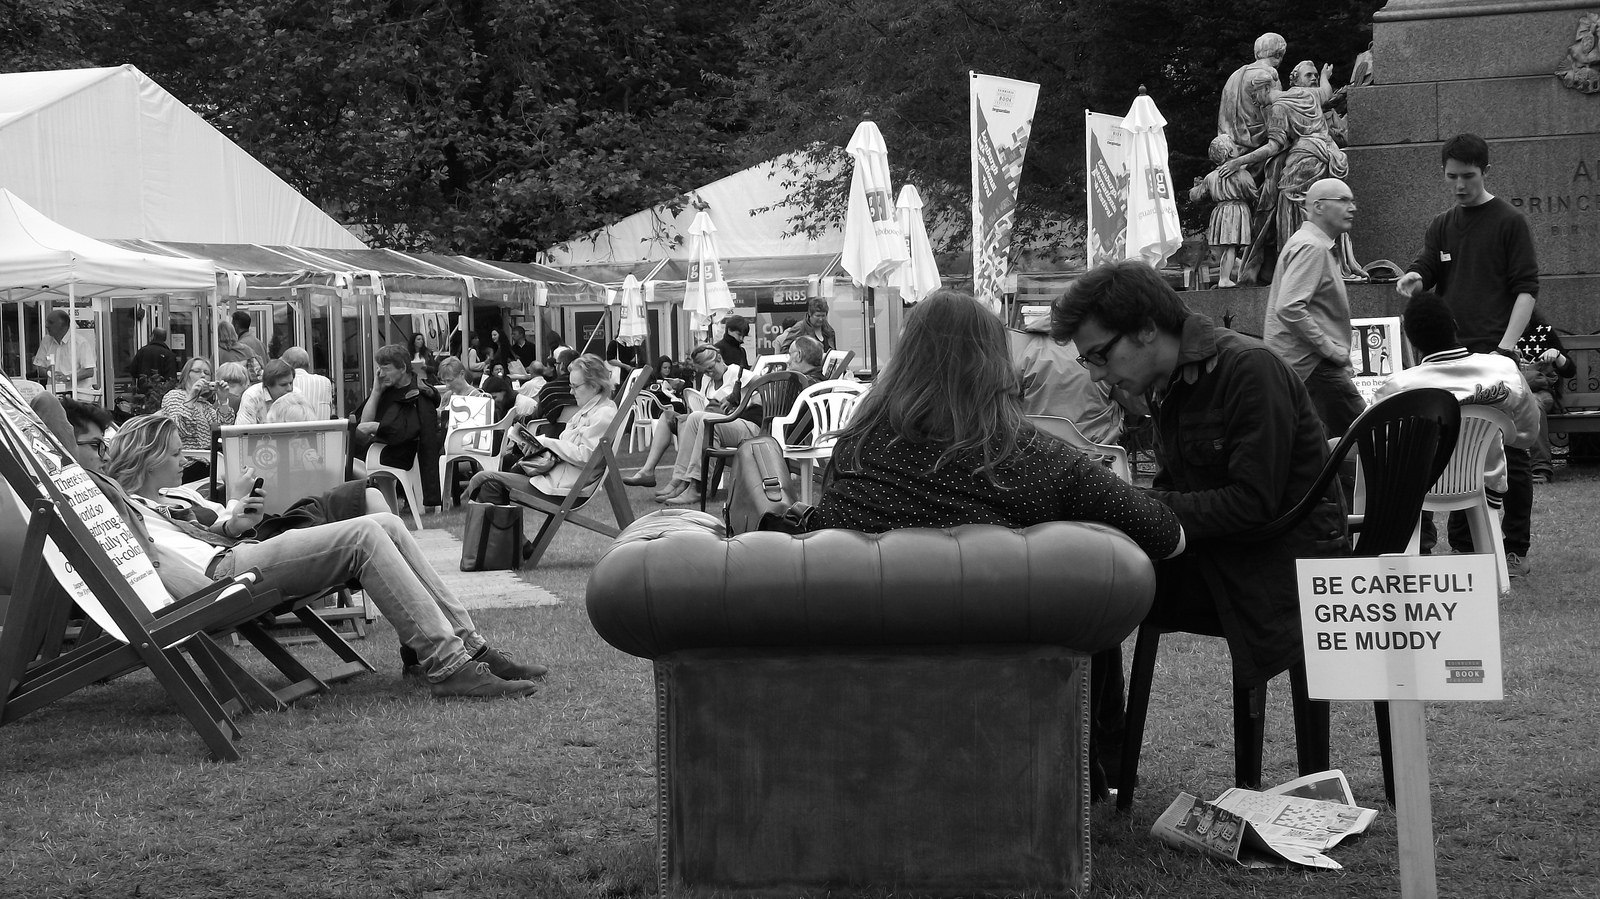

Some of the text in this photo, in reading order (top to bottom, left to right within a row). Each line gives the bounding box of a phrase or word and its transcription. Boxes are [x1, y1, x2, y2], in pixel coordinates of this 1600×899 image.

[785, 290, 807, 302] RBS
[54, 472, 84, 492] There's
[73, 490, 91, 505] this
[94, 503, 104, 516] so
[1312, 573, 1474, 595] BE CAREFUL!
[1314, 602, 1458, 623] GRASS MAY
[1316, 631, 1442, 650] BE MUDDY
[1455, 670, 1480, 678] BOOK
